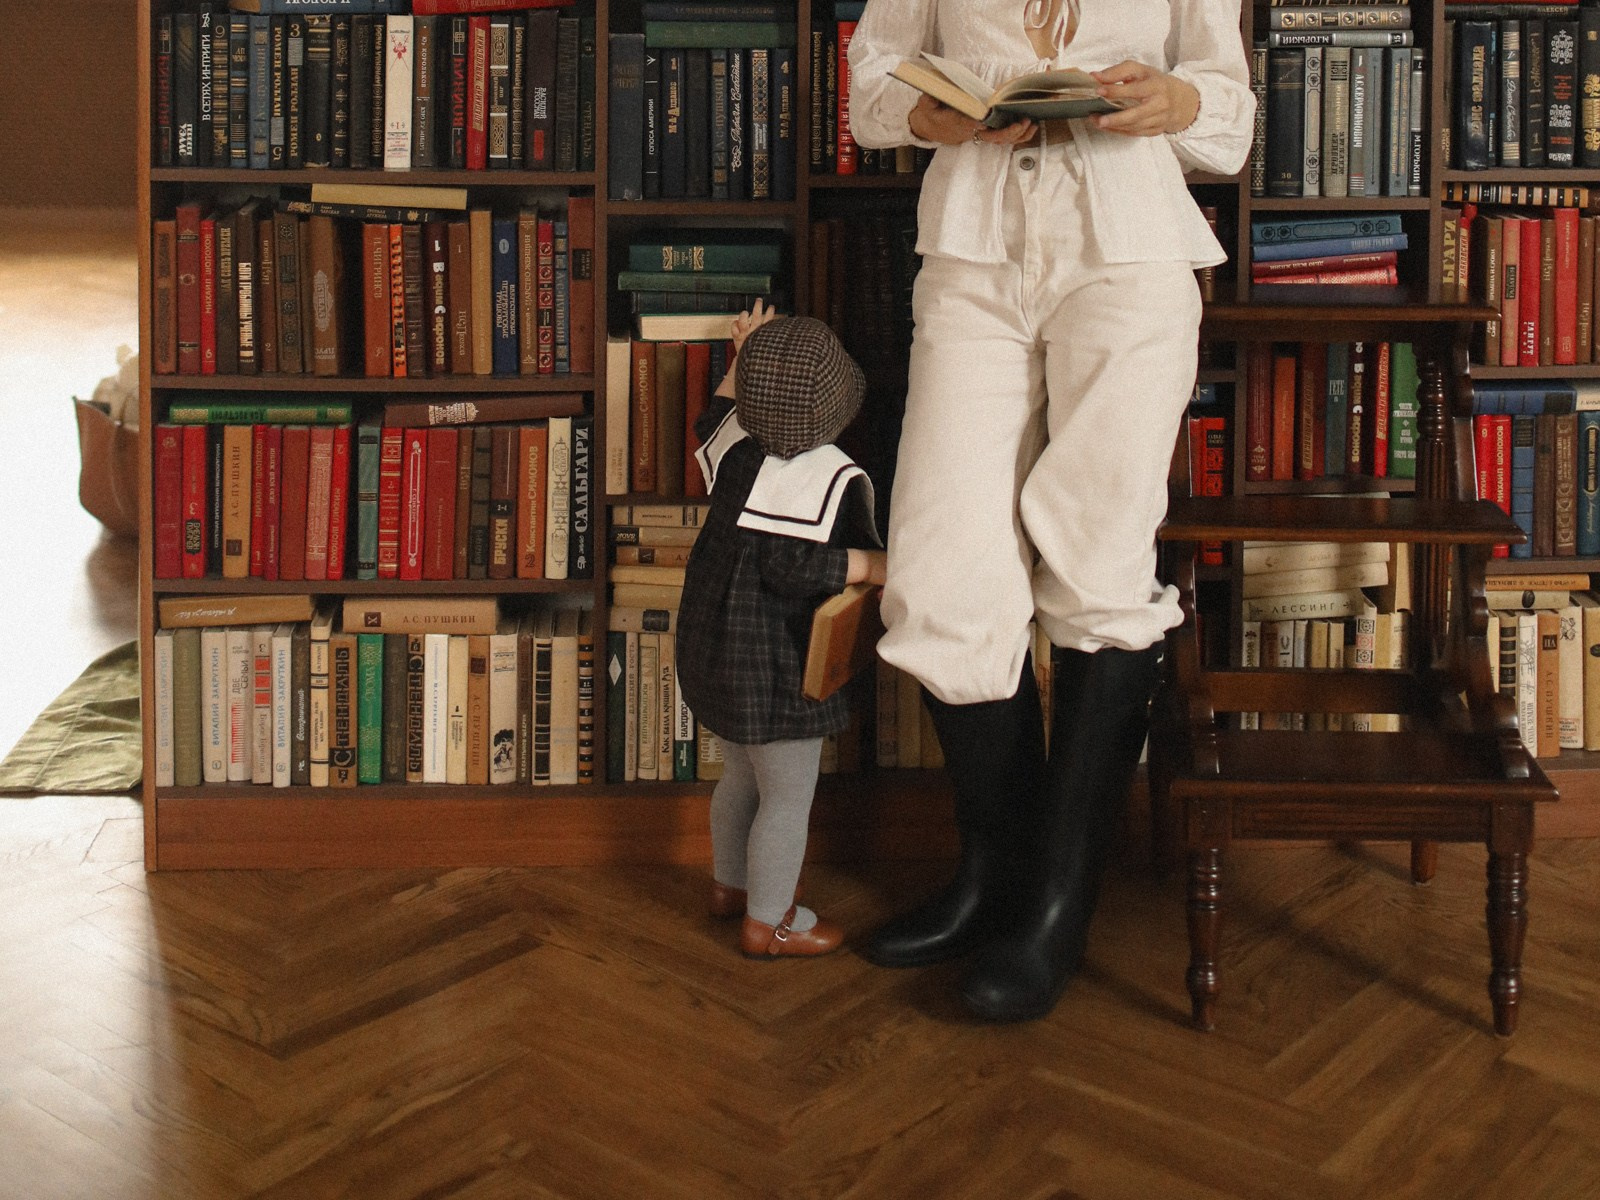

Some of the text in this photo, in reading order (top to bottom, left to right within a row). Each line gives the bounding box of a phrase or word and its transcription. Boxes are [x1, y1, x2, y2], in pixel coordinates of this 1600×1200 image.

[201, 34, 211, 80] ИНТРИГИ
[274, 26, 282, 117] РОМЕН РОЛЛАН
[647, 98, 656, 156] ГОЛОСА АМЕРИКИ
[204, 233, 212, 315] МИХАИЛ ШОЛОХОВ
[637, 358, 649, 412] СИМОНОВ
[231, 445, 241, 498] ПУШКИН
[527, 446, 539, 500] СИМОНОВ
[575, 427, 589, 533] САЛЬГАРИ
[1496, 425, 1504, 503] МИХАИЛ ШОЛОХОВ
[493, 518, 509, 565] БРУСКИ
[211, 647, 220, 747] ВИТАЛИЙ ЗАКРУТКИН
[275, 649, 286, 749] ВИТАЛИЙ ЗАКРУТКИН
